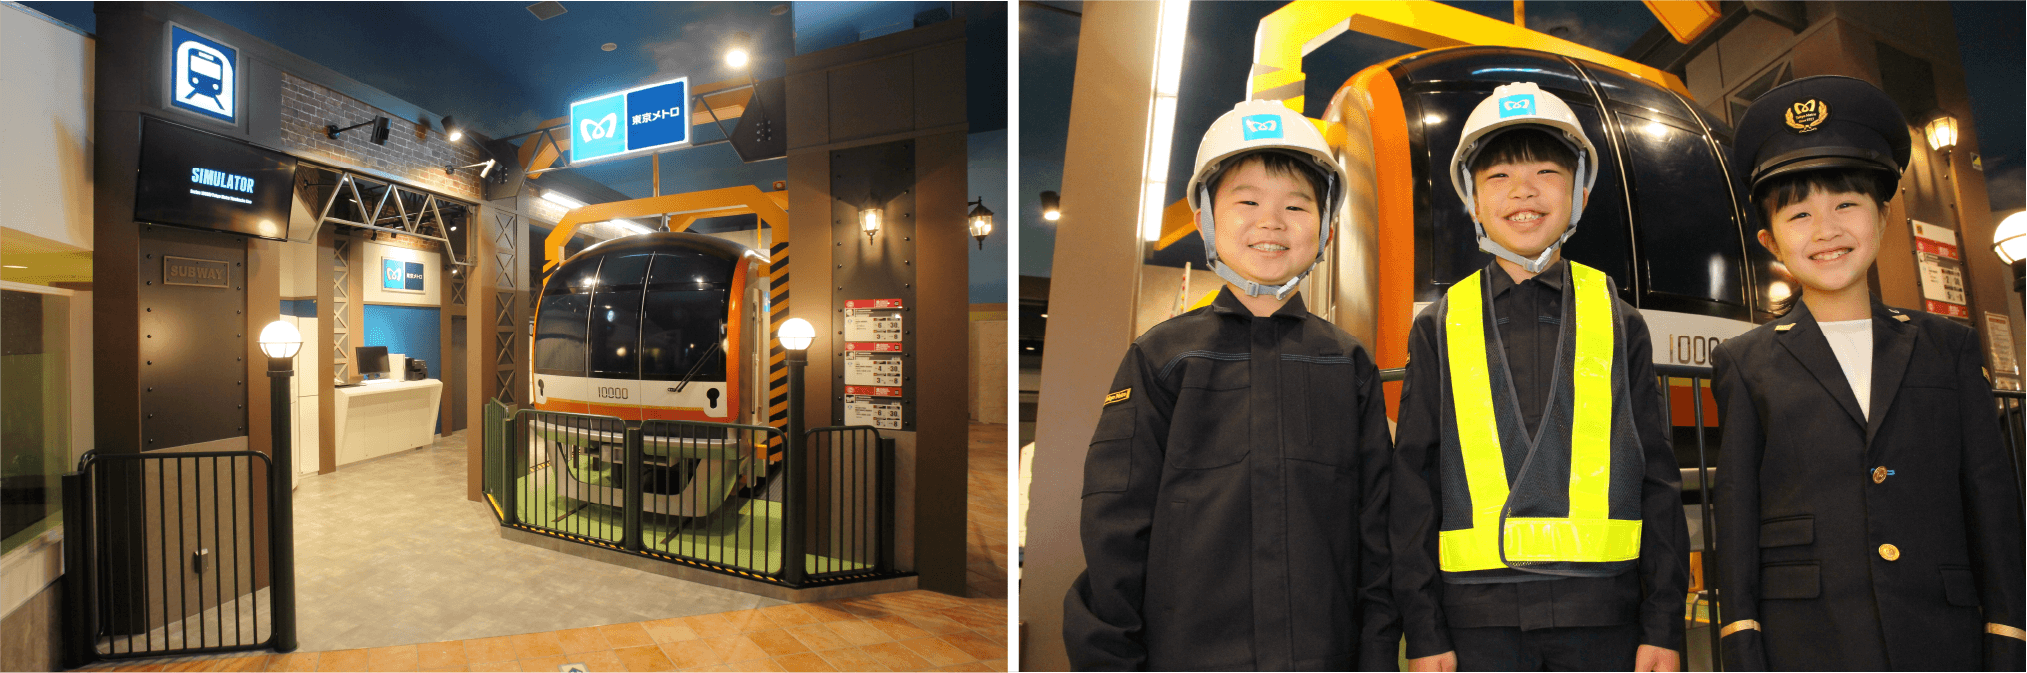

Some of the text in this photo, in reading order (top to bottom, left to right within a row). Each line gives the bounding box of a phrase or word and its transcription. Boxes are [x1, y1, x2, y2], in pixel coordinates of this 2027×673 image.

[631, 106, 680, 126] 東京メトロ
[191, 167, 255, 194] SIMULATOR
[170, 265, 223, 280] SUBWAY
[597, 386, 629, 400] 10000
